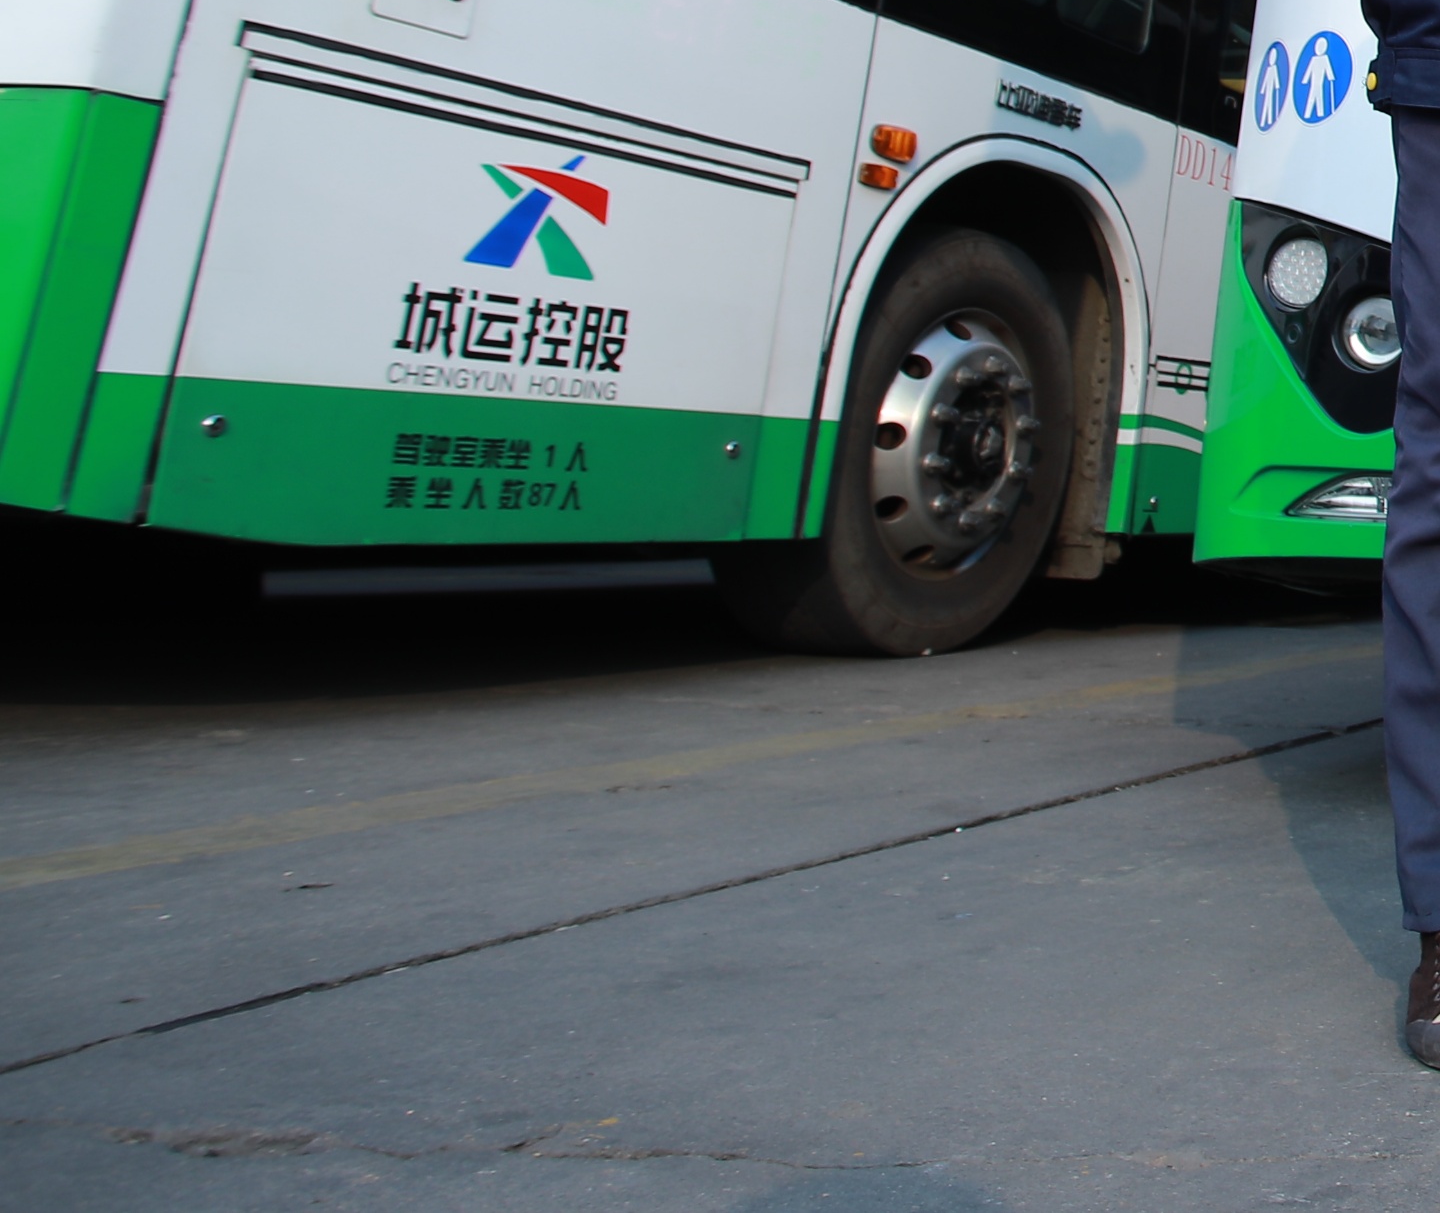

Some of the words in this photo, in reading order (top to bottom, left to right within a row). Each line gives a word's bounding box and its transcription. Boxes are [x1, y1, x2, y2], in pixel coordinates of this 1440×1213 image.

[393, 282, 630, 373] 城运控股
[387, 362, 516, 393] CHENGYUN
[528, 374, 619, 401] HOLDING
